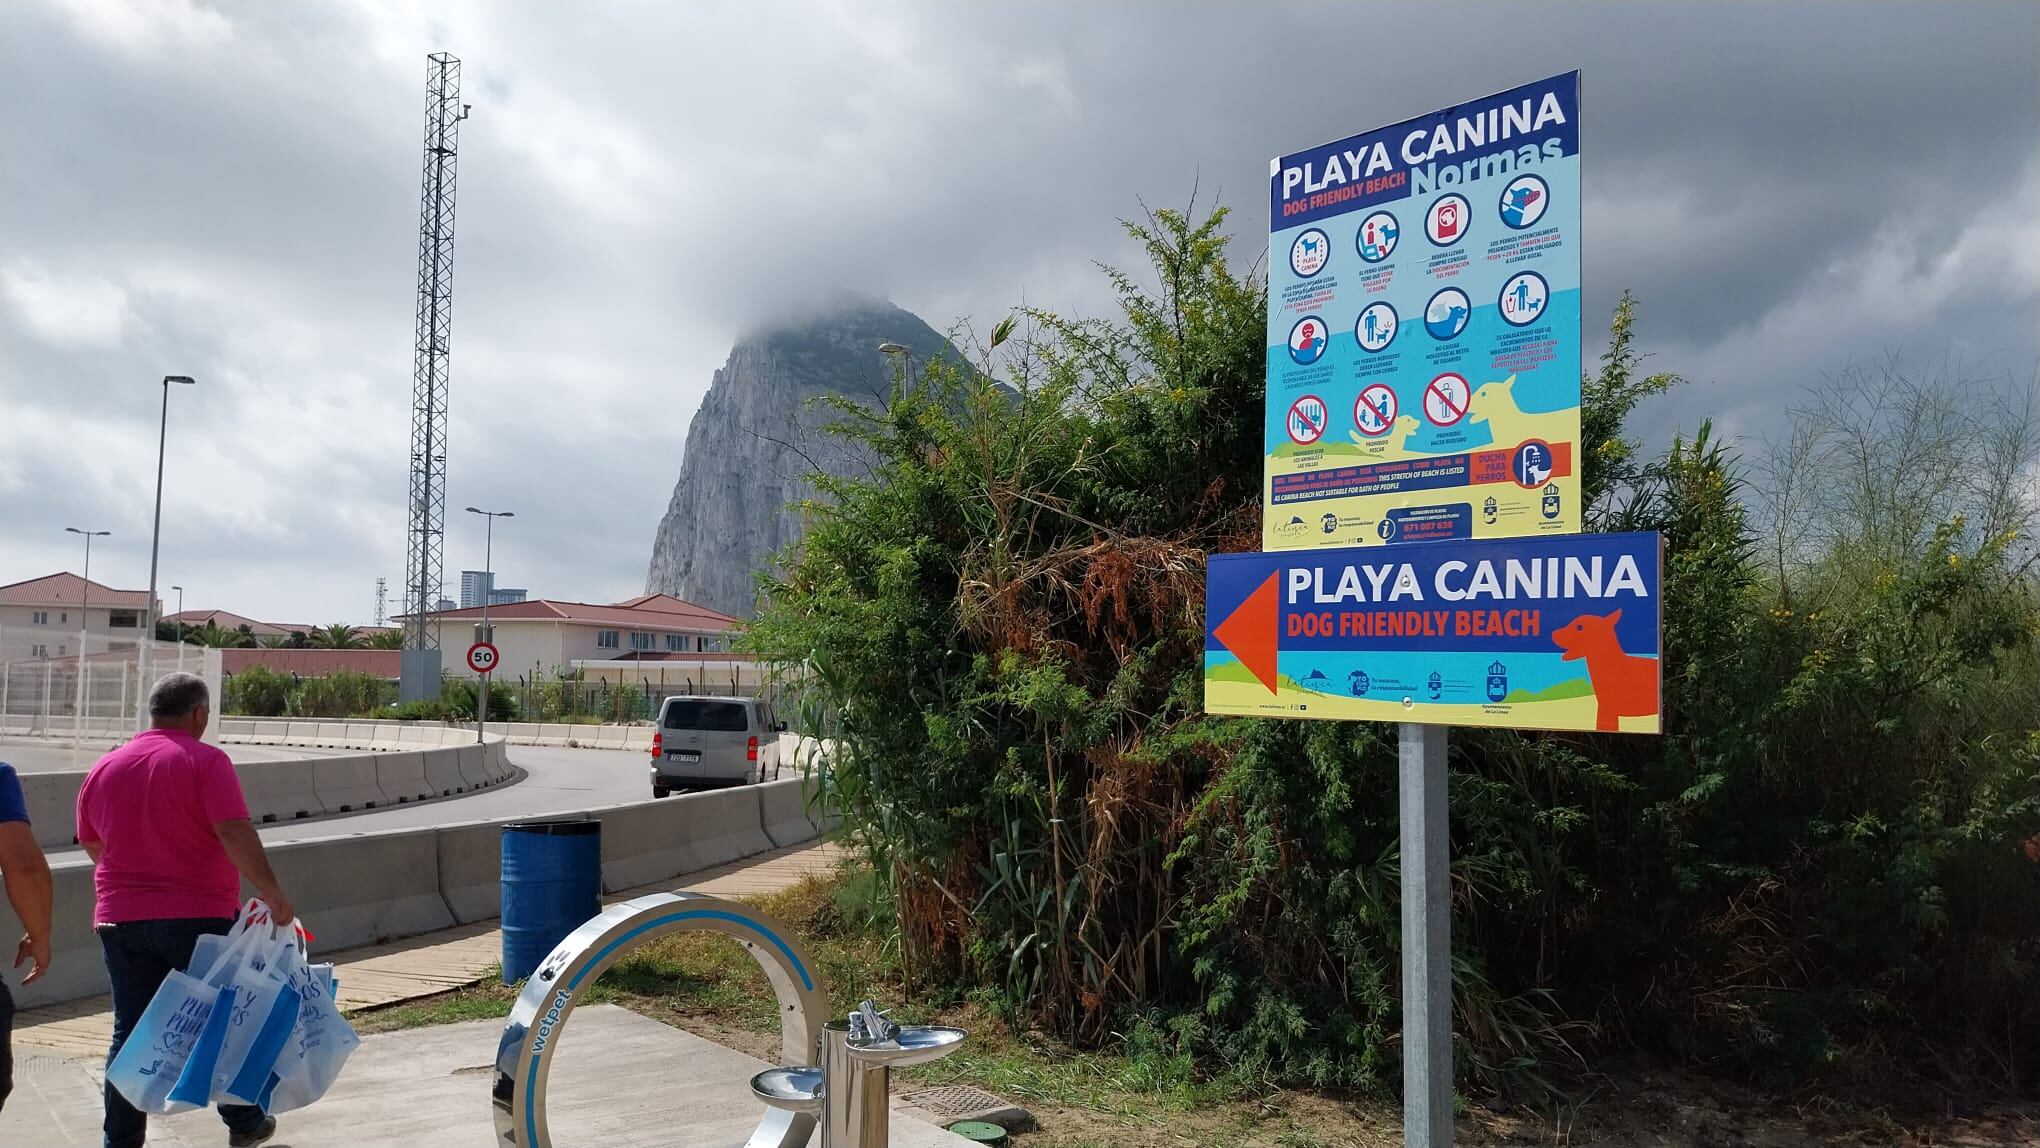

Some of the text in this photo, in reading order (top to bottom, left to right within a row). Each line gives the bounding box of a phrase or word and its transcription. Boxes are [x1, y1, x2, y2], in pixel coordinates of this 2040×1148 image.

[1283, 92, 1566, 200] PLAYA CANINA
[1411, 138, 1563, 194] Normas
[1283, 171, 1405, 217] DOG FRIENDLY BEACH
[1499, 236, 1516, 244] PERROS
[1518, 227, 1558, 240] POTENCIALMENTE
[1488, 243, 1515, 253] PELIGROSOS
[1534, 240, 1561, 250] OBLIGADOS
[1429, 254, 1467, 267] SIEMPRE CONSIGO
[1377, 263, 1394, 271] SIEMPRE
[1444, 269, 1459, 277] PERRO
[1502, 329, 1533, 339] OBLIGATORIO
[1443, 342, 1459, 350] CAUSAR
[1490, 346, 1512, 354] MASCOTA
[1365, 439, 1388, 447] PROHIBIDO
[1480, 453, 1506, 463] DUCHA
[1486, 462, 1506, 471] PARA
[1391, 472, 1412, 480] STRETCH
[1421, 469, 1438, 477] BEACH
[1446, 466, 1464, 474] LISTED
[1476, 472, 1506, 480] PERROS
[1325, 488, 1347, 496] SUITABLE
[1379, 482, 1399, 490] PEOPLE
[1420, 522, 1434, 530] 007
[1288, 555, 1648, 604] PLAYA CANINA
[1288, 609, 1540, 637] DOG FRIENDLY BEACH
[474, 652, 492, 662] 50
[532, 989, 572, 1053] wetpet
